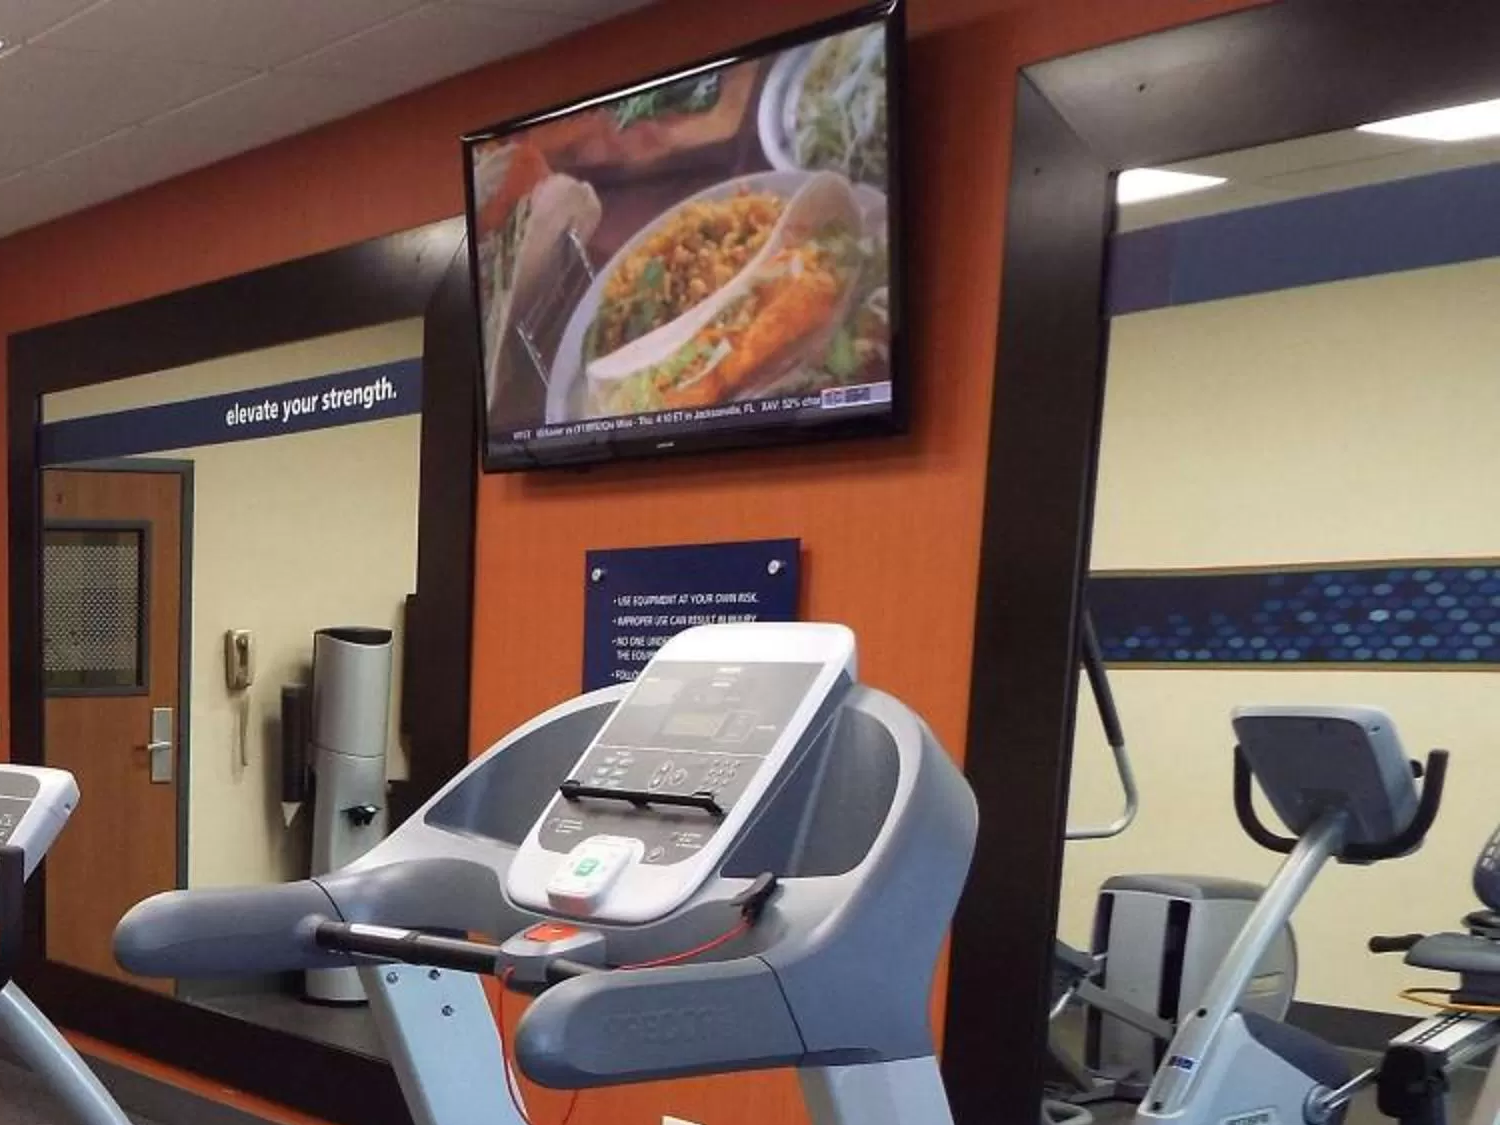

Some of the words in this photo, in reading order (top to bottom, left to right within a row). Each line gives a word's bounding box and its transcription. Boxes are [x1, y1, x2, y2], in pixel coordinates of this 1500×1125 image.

[225, 399, 279, 426] elevate
[282, 393, 318, 423] your
[320, 375, 398, 410] strength.
[617, 594, 631, 607] USE
[633, 593, 678, 607] EQUIPMENT
[678, 593, 688, 605] AT
[689, 592, 713, 605] YOUR
[715, 592, 737, 604] OWN
[617, 615, 653, 627] IMPROPER
[669, 614, 686, 626] CAN
[616, 635, 629, 647] NO
[630, 635, 645, 647] ONE
[646, 635, 671, 646] UNDE
